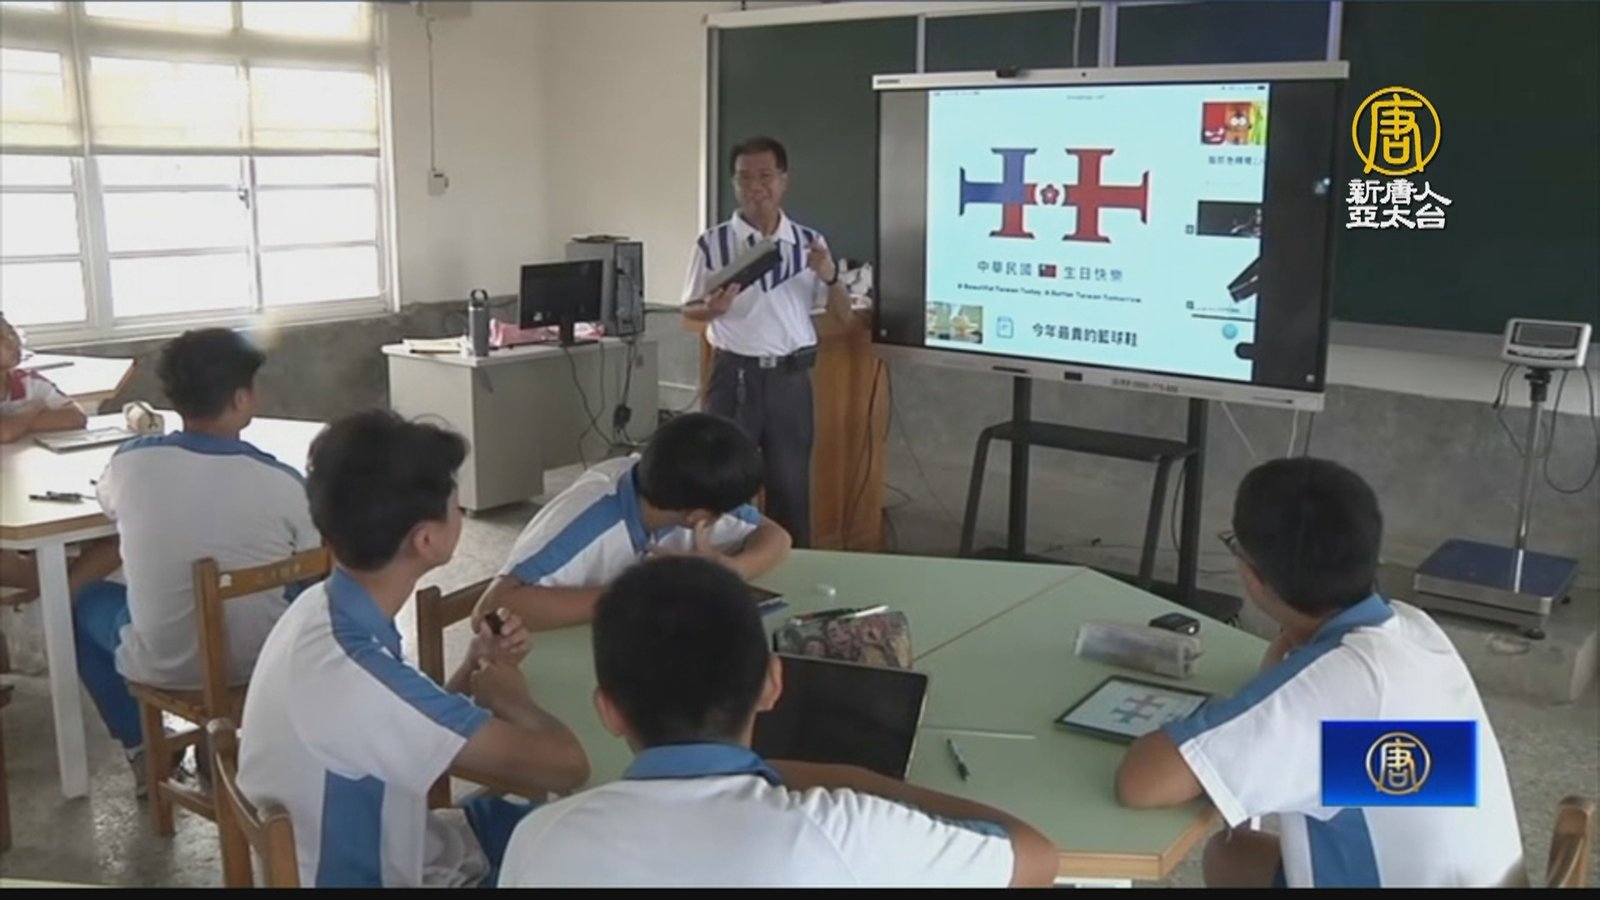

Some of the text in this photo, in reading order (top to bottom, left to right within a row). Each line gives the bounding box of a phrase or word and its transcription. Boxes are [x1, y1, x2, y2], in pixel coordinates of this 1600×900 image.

[977, 260, 1123, 282] 中華民國 生日快樂
[1032, 322, 1138, 347] 今年最貴的籃球鞋
